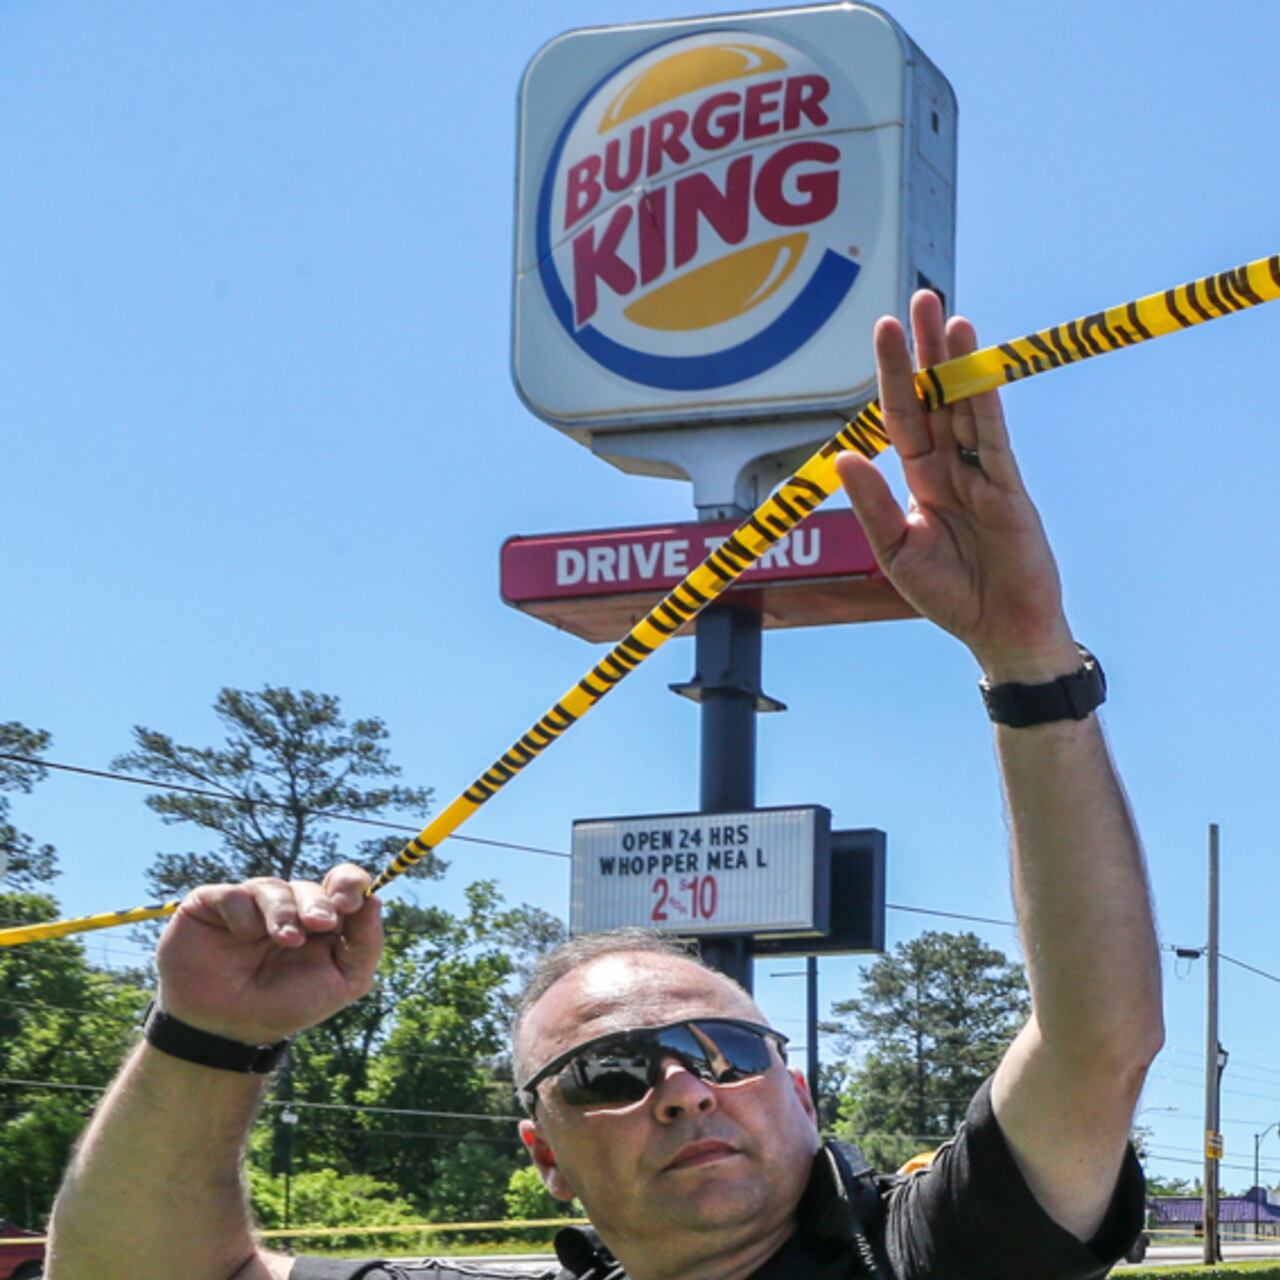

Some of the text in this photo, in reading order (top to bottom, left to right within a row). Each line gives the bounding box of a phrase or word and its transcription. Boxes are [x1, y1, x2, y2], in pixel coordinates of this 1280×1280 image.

[564, 74, 830, 231] BURGER
[572, 141, 841, 327] KING
[556, 528, 820, 586] DRIVE TRU
[622, 825, 749, 852] OPEN 24 HRS
[600, 853, 698, 876] WHOPPER
[651, 879, 669, 920] 2
